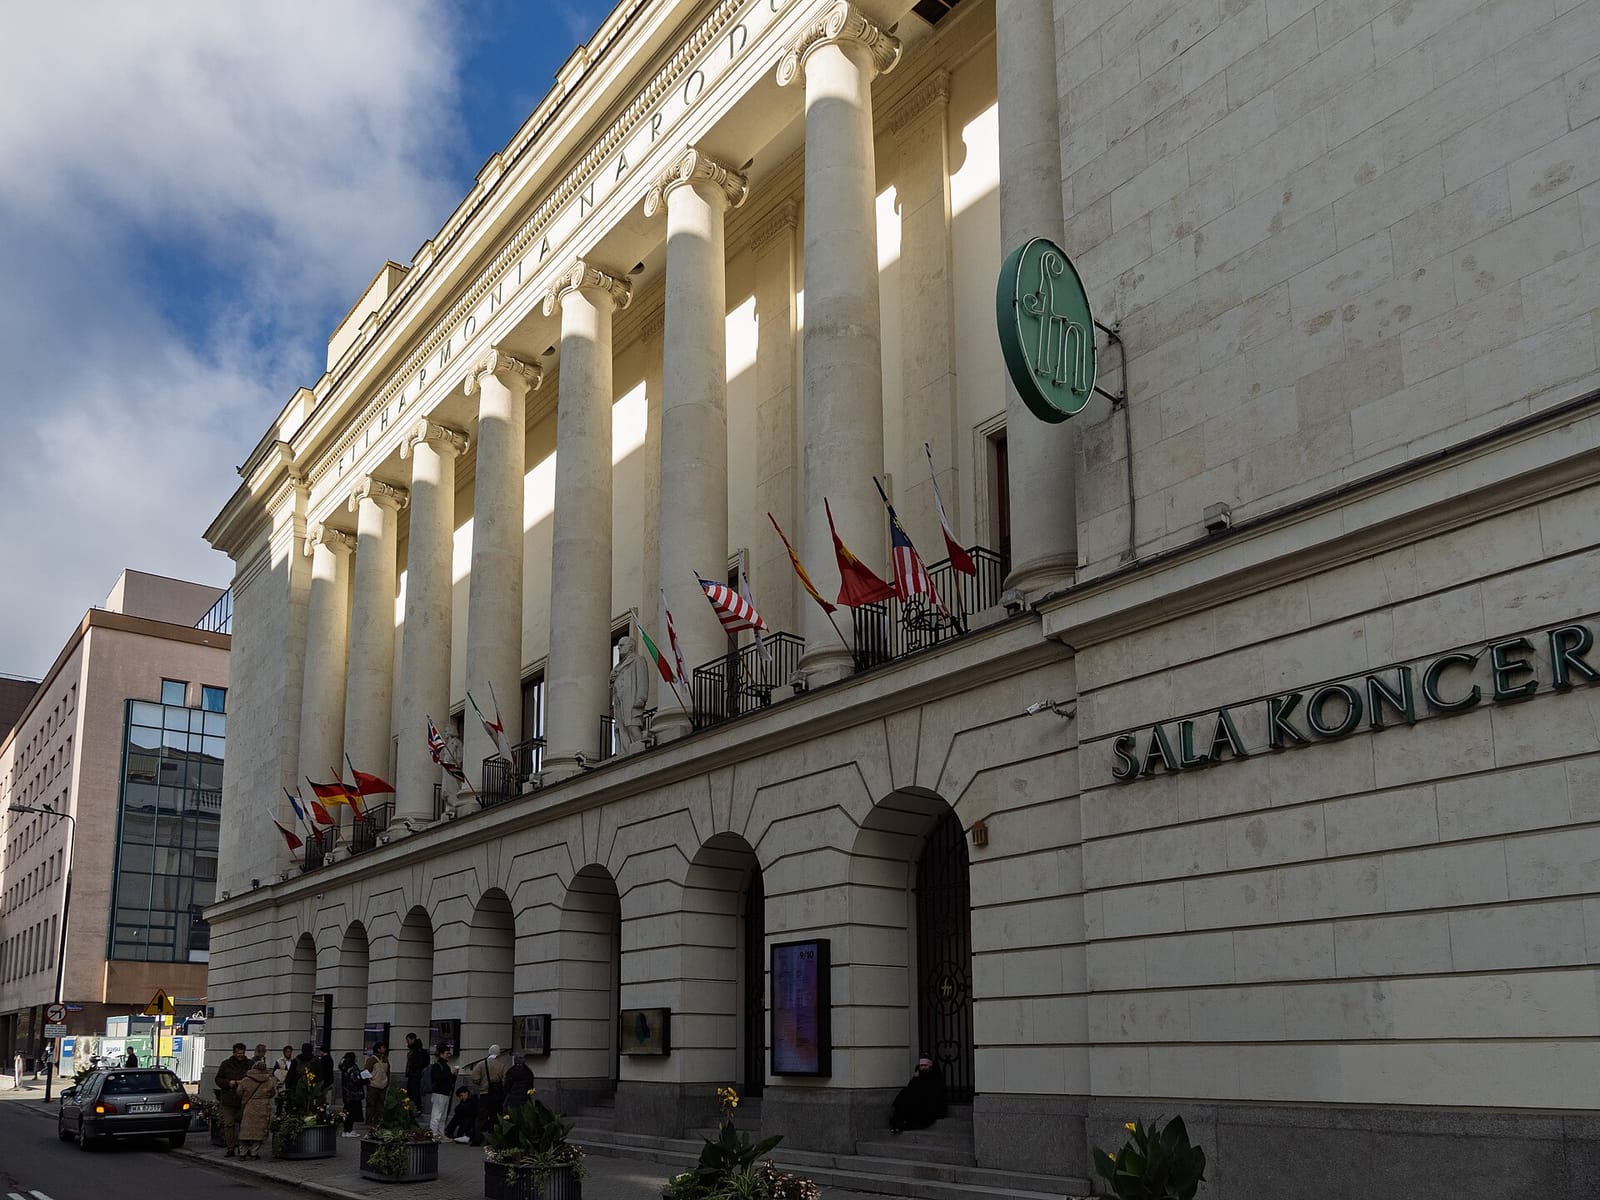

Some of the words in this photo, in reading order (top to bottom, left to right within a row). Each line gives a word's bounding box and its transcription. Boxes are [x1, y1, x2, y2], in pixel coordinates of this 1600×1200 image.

[338, 236, 552, 478] FILHARMONIA
[1112, 709, 1249, 780] SALA
[1267, 624, 1600, 749] KONCER
[799, 950, 815, 960] 9/10
